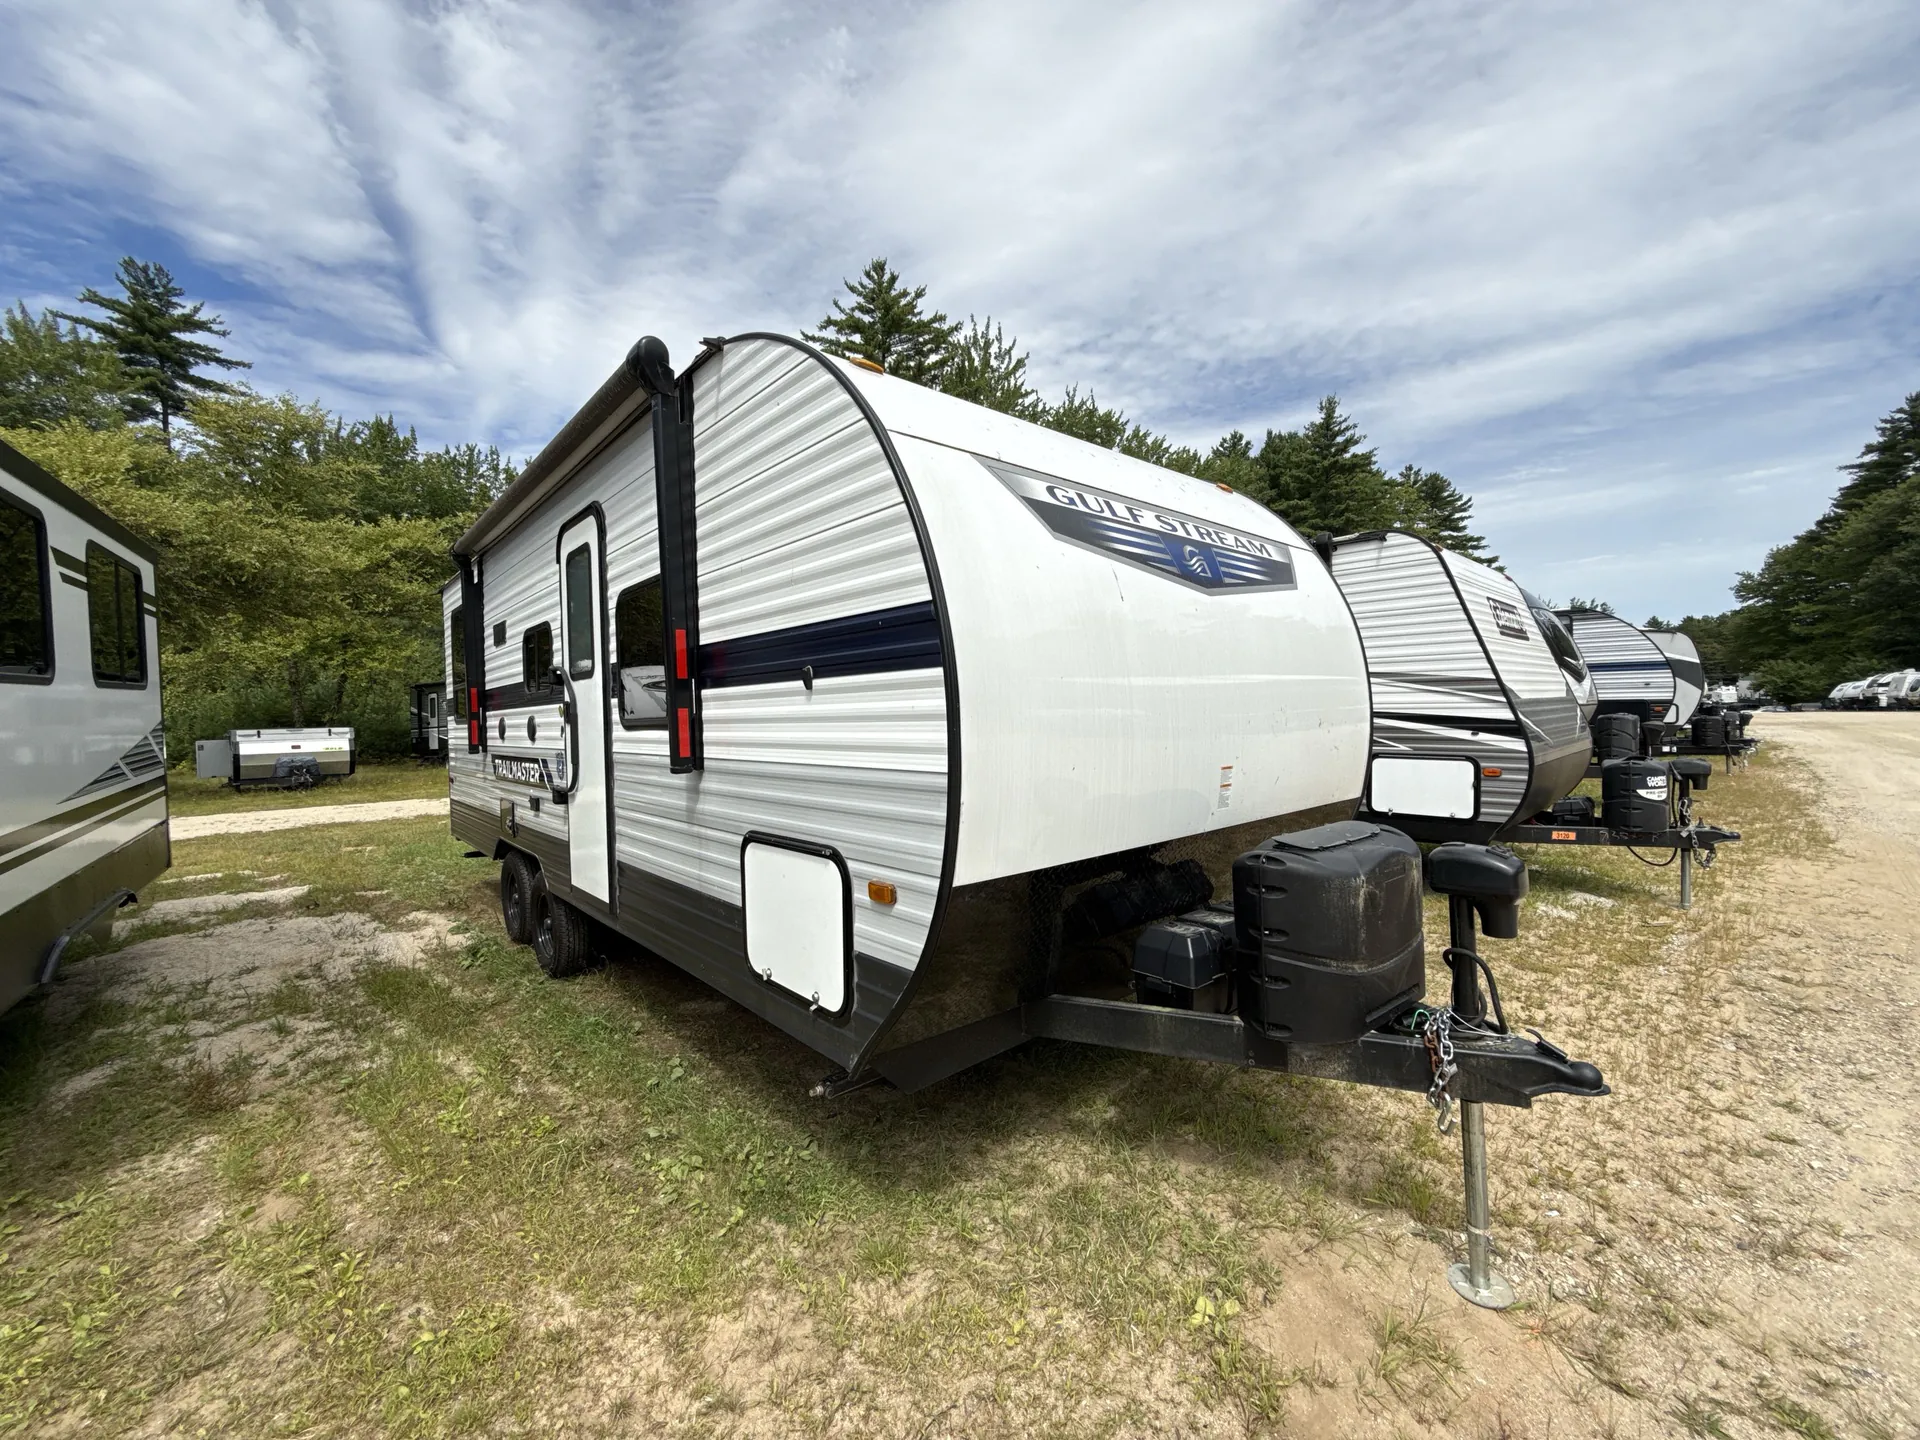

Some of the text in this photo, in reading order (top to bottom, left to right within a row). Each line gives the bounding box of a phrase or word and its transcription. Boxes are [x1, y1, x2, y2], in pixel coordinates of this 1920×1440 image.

[1045, 485, 1273, 558] GULF STREAM
[495, 759, 540, 784] TRAILMASTER
